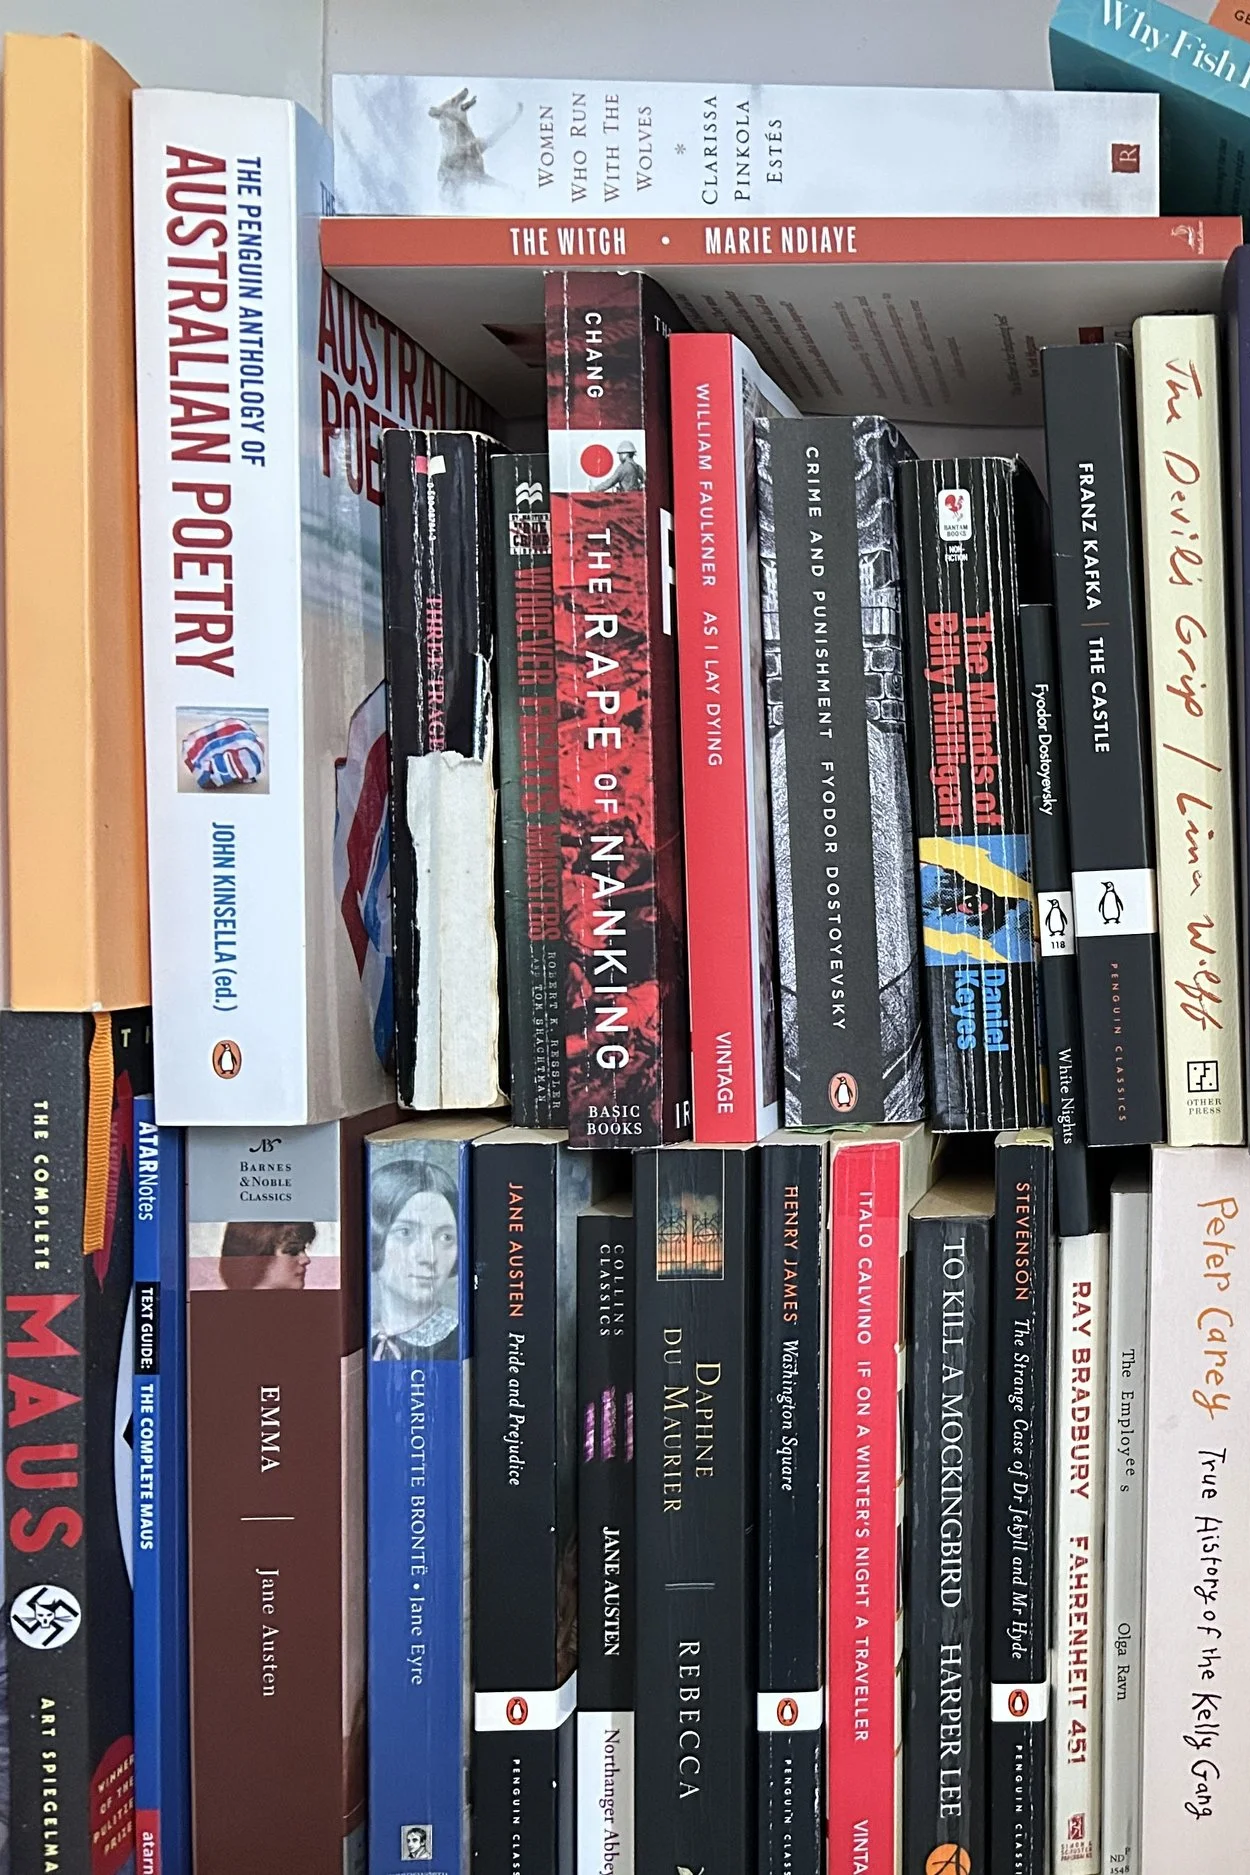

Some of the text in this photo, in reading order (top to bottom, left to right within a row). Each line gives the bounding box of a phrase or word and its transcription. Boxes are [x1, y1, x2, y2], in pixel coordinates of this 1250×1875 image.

[1101, 1, 1170, 54] Why
[1171, 29, 1237, 83] Fish
[538, 104, 554, 188] WOMEN
[570, 92, 588, 202] WHO RUN
[603, 93, 620, 202] WITH THE
[636, 104, 653, 192] WOLVES
[701, 95, 718, 205] CLARISSA
[735, 99, 751, 201] PINKOLA
[766, 118, 783, 184] ESTÉS
[510, 228, 625, 255] THE WITCH
[705, 226, 857, 254] MARIE NDIAYE
[237, 156, 265, 467] THE PENGUIN ANTHOLOGY OF
[165, 145, 235, 678] AUSTRALIAN POETRY
[806, 445, 832, 740] CRIME AND PUNISHMENT
[1078, 462, 1110, 753] FRANZ KAFKA THE CASTLE
[584, 527, 630, 1070] THE RAPE OF NANKING
[1031, 684, 1054, 817] Fyodor Dostoyevsky
[211, 822, 239, 1011] JOHN KINSELLA (ed.)
[821, 760, 847, 1030] FYODOR DOSTOYEVSKY
[1051, 941, 1066, 949] 118
[715, 1031, 734, 1114] VINTAGE
[1057, 1048, 1073, 1145] White Nights
[1109, 962, 1127, 1122] PENGUIN CLASSICS
[588, 1105, 640, 1118] BASIC
[32, 1100, 50, 1271] THE COMPLETE
[504, 1183, 525, 1487] JANE AUSTEN Pride and Prejudice
[613, 1244, 625, 1337] COLLINS
[6, 1293, 84, 1553] MAUS
[139, 1288, 155, 1551] TEXT GUIDE: THE COMPLETE MAUS
[260, 1385, 281, 1473] EMMA
[406, 1369, 429, 1686] CHARLOTTE BRONTË Jane Eyre
[940, 1238, 965, 1819] TO KILL A MOCKINGBIRD HARPER LEE
[1067, 1282, 1091, 1764] RAY BRADBURY FAHRENHEIT 451
[255, 1568, 280, 1699] Jane Austen
[603, 1527, 620, 1657] JANE AUSTEN
[679, 1641, 700, 1800] REBECCA
[1114, 1622, 1131, 1701] Olga Ravn
